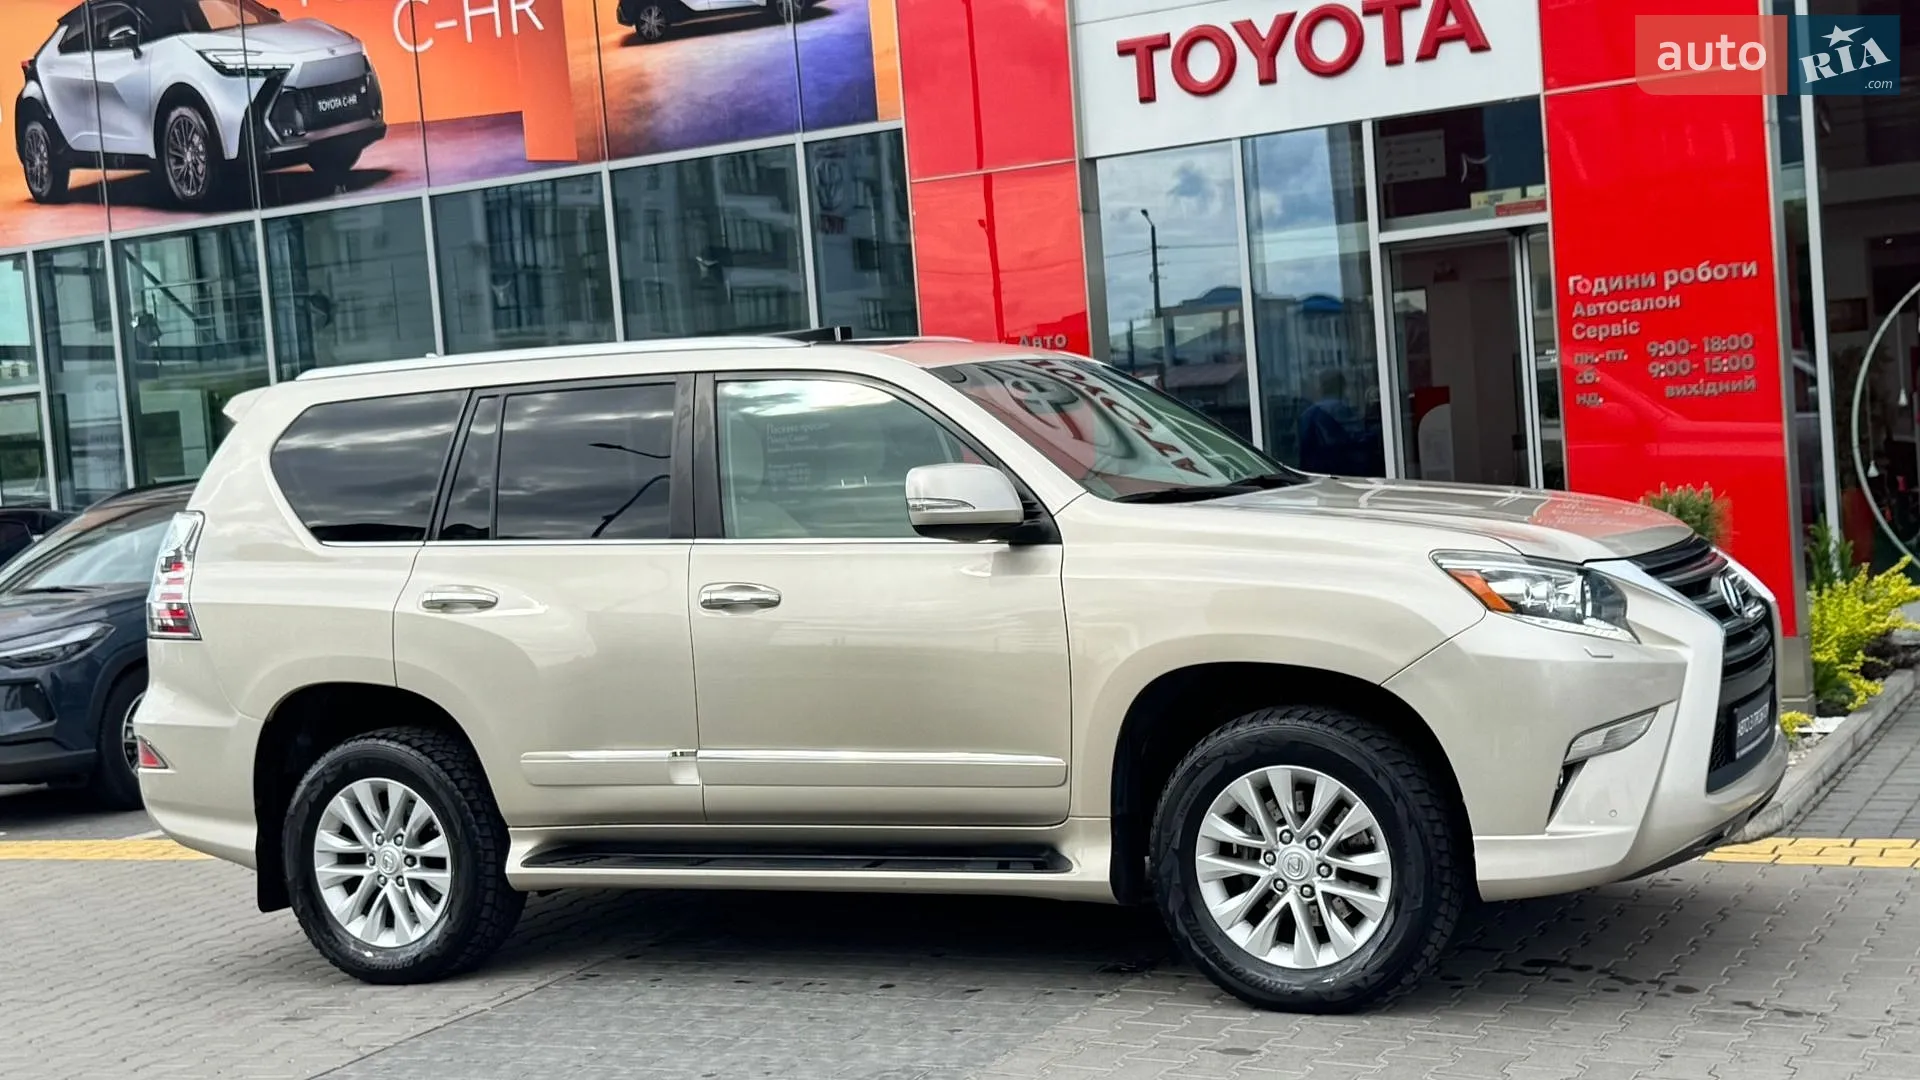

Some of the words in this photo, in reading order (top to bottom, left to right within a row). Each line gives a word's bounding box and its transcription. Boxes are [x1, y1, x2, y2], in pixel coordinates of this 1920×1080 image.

[393, 0, 544, 52] C-HR
[1116, 0, 1492, 104] TOYOTA
[318, 97, 342, 112] TOYOTA
[1567, 271, 1656, 297] Години
[1663, 260, 1758, 291] роботи
[1572, 295, 1681, 319] Автосалон
[1572, 318, 1641, 342] Сервіс
[1665, 375, 1757, 398] вихідний
